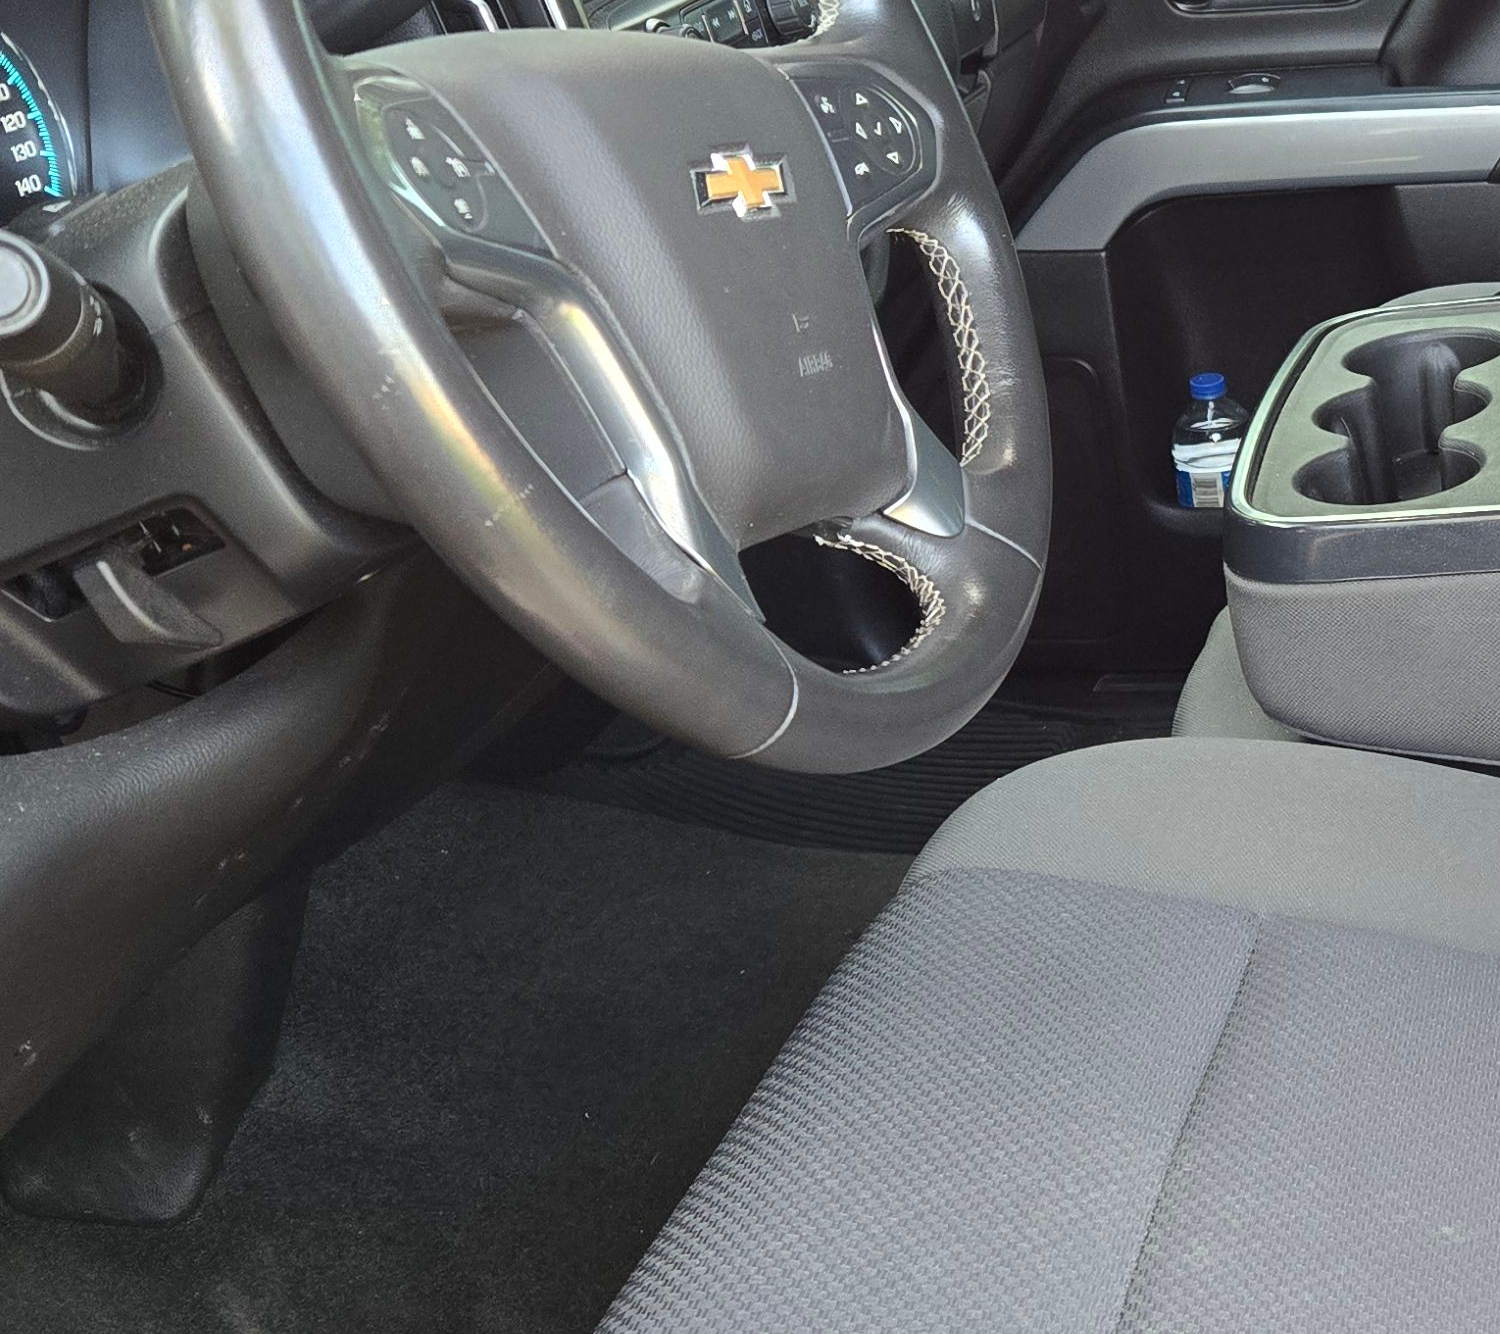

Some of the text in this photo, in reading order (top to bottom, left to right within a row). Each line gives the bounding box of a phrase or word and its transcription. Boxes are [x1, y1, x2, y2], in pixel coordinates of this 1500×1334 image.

[0, 111, 26, 133] 120
[11, 140, 37, 162] 130
[15, 174, 42, 197] 140
